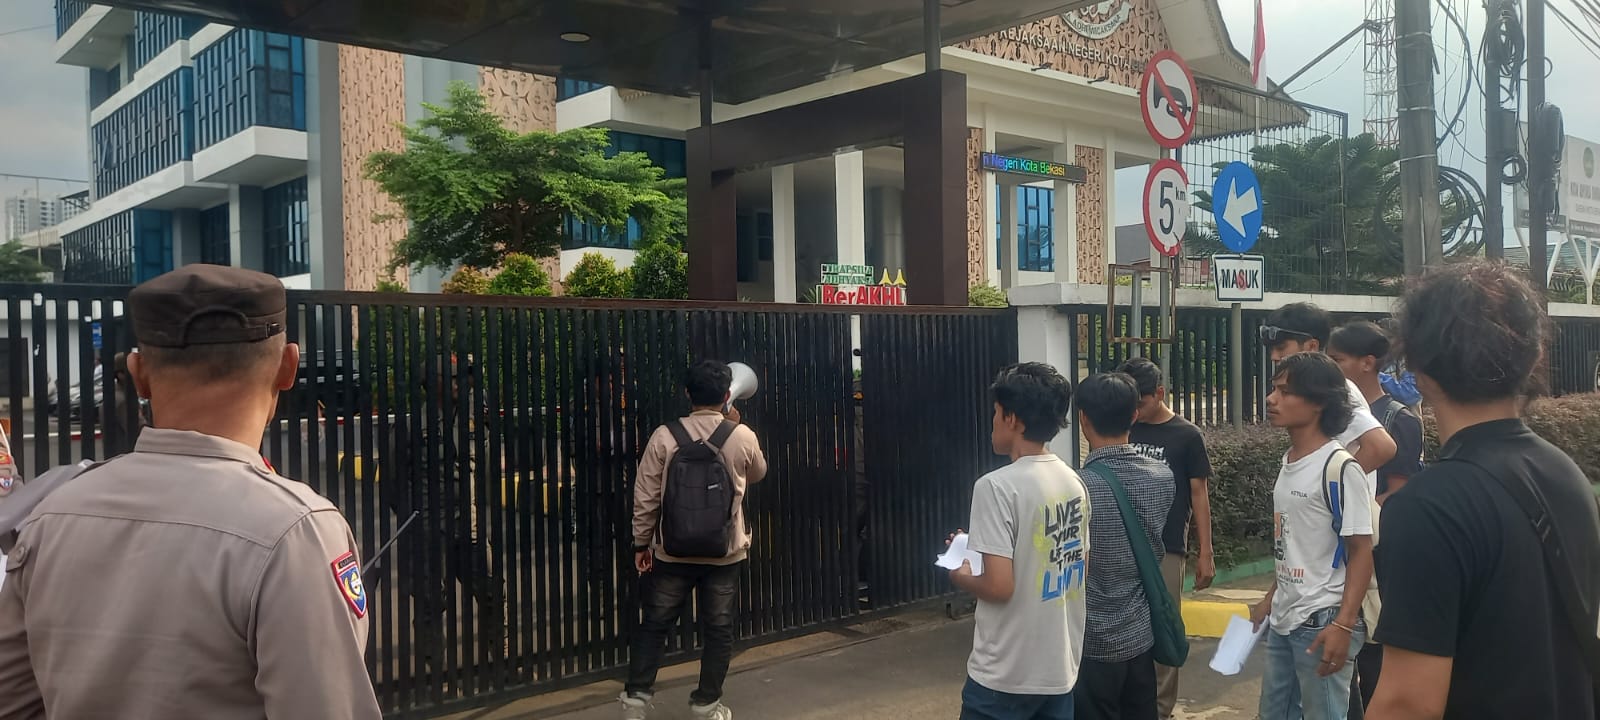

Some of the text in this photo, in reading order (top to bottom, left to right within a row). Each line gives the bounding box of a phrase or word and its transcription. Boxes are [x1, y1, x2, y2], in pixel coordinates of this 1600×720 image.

[1068, 42, 1105, 62] NEGERI
[991, 153, 1018, 171] Negeri
[1020, 159, 1038, 172] Kota
[1040, 162, 1065, 176] Bekasi
[1159, 181, 1174, 235] 5
[1175, 186, 1186, 201] km
[1221, 269, 1259, 289] MASUK
[1045, 496, 1082, 537] LIVE
